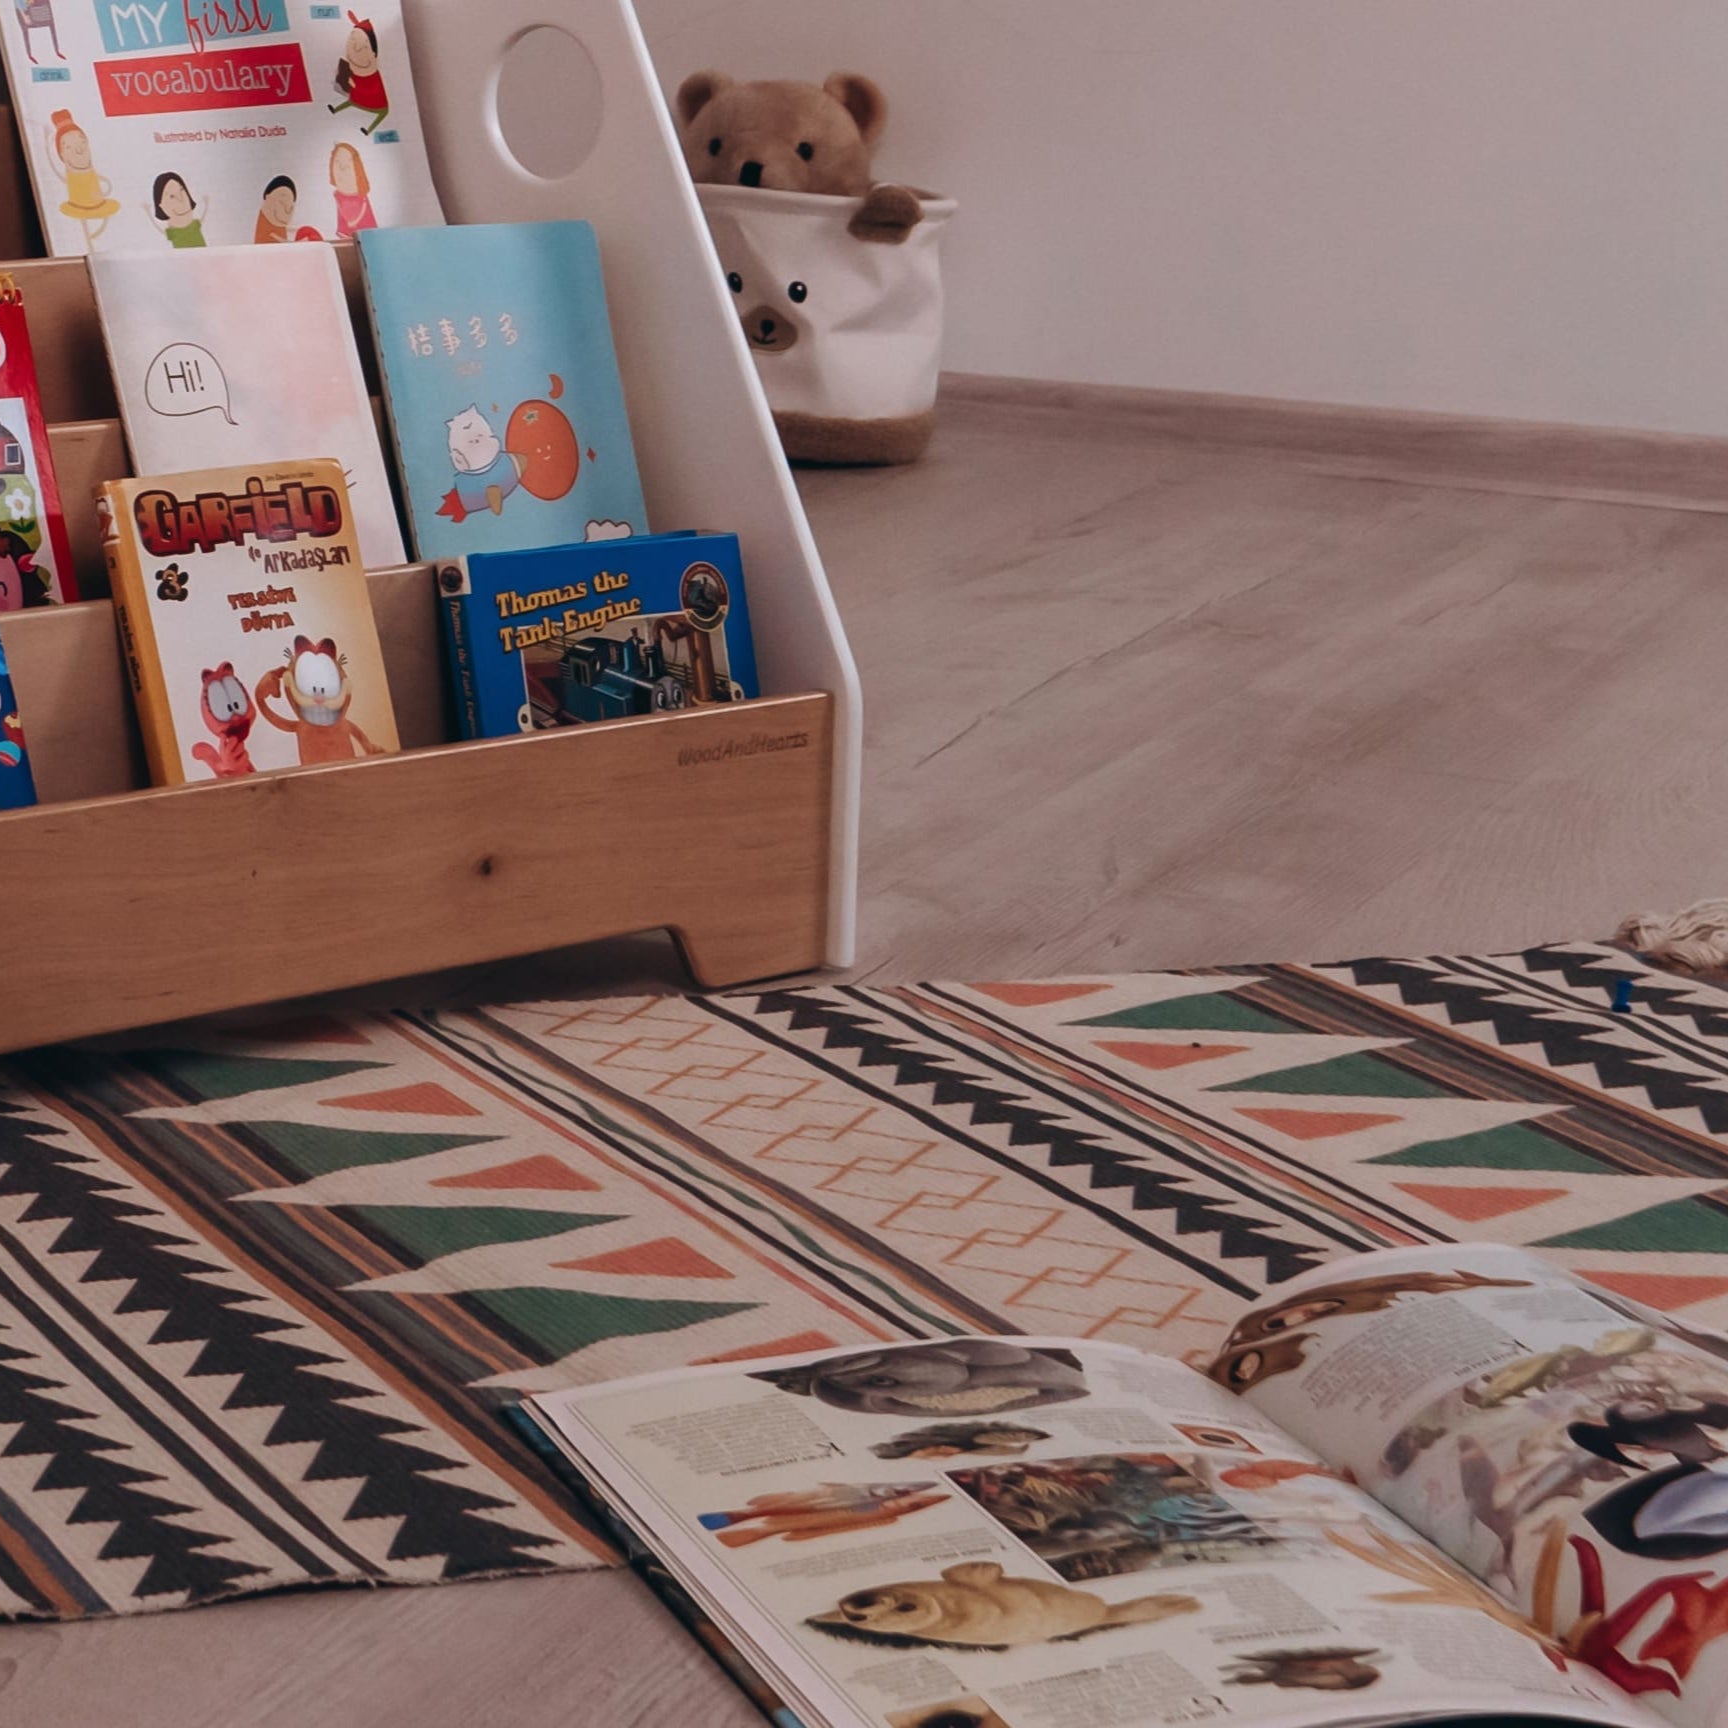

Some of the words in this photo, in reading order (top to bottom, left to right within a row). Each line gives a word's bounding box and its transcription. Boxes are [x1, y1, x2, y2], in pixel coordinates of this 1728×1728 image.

[109, 1, 169, 49] MY
[110, 60, 294, 103] vocabulary
[204, 129, 217, 143] by
[258, 125, 288, 138] Duda
[162, 359, 206, 394] Hi!
[495, 580, 588, 620] Thomas
[593, 571, 630, 594] the
[499, 616, 560, 653] Tank
[562, 598, 642, 635] Engine
